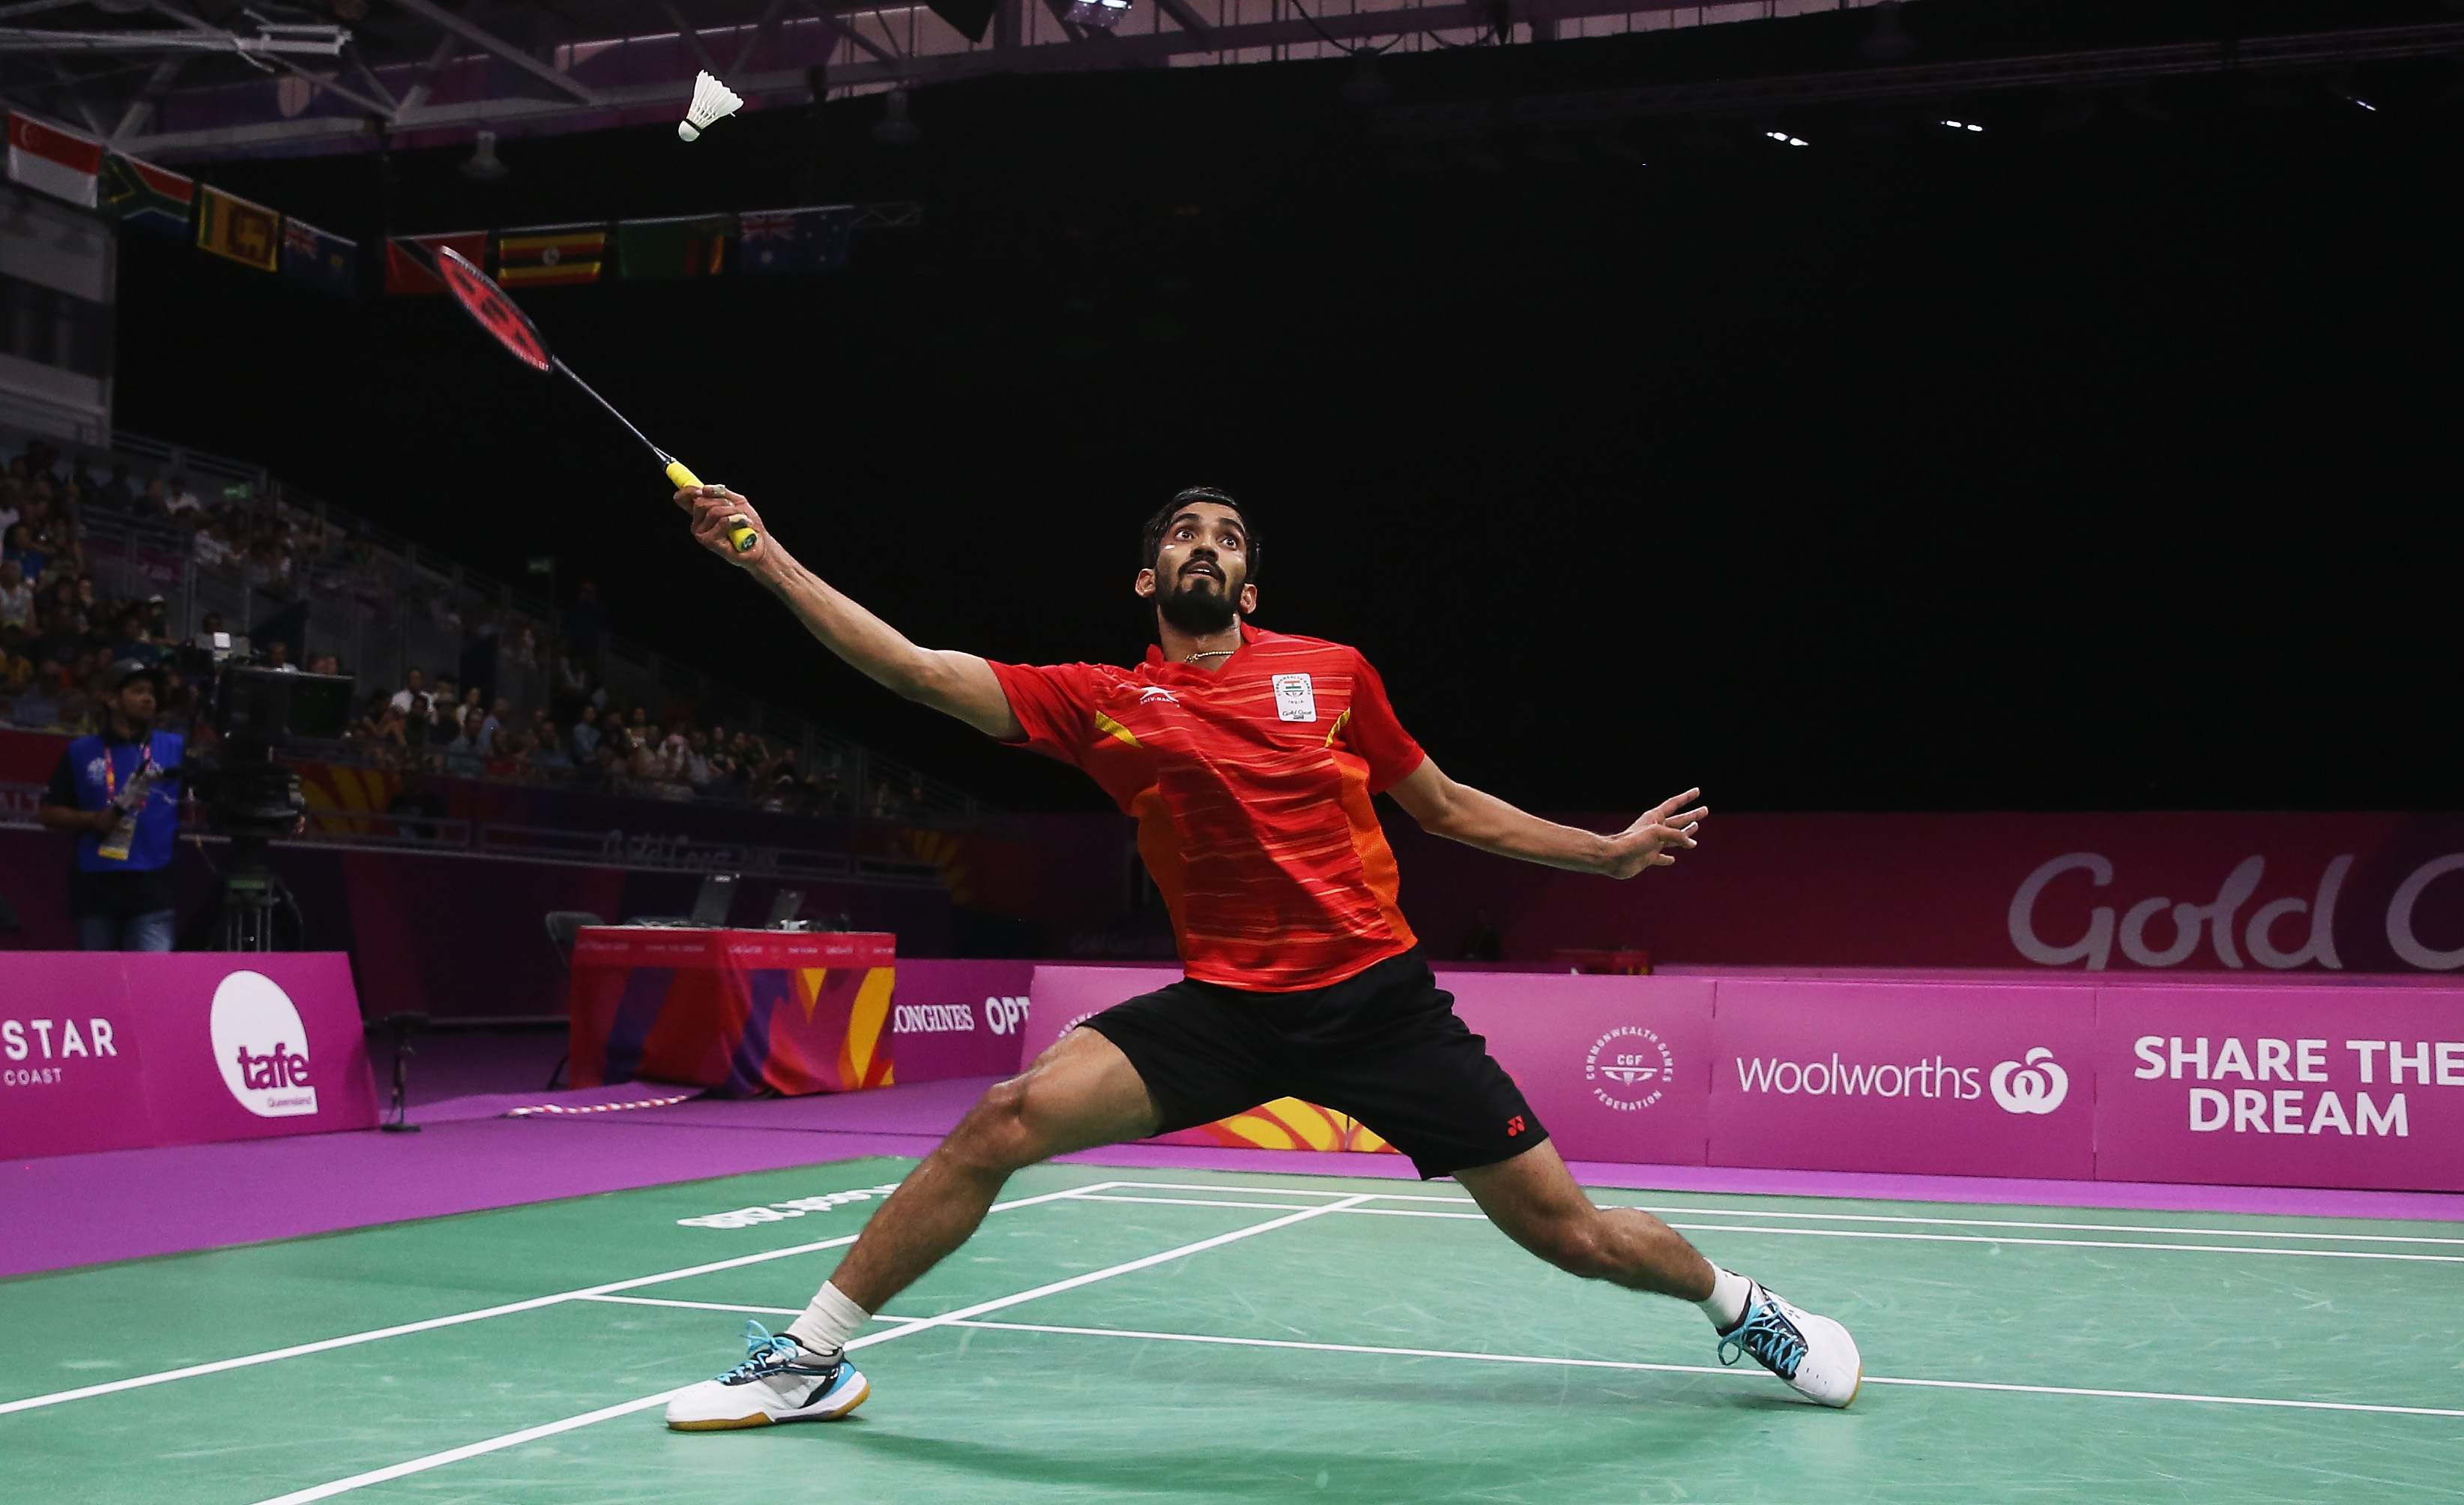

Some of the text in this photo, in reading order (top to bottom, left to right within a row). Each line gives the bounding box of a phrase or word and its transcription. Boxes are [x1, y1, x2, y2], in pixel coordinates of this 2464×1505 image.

[2008, 851, 2355, 971] Gold
[1, 1017, 118, 1061] STAR
[893, 1004, 975, 1033] ONGINES
[3, 1068, 63, 1086] COAST
[238, 1043, 309, 1090] tafe
[1585, 1026, 1673, 1082] COMMONWEALTH GAMES
[1616, 1053, 1643, 1066] CGF
[1736, 1052, 1982, 1100] Woolworths
[2134, 1035, 2464, 1086] SHARE THE
[1594, 1088, 1663, 1111] FEDERATION
[2188, 1088, 2409, 1137] DREAM
